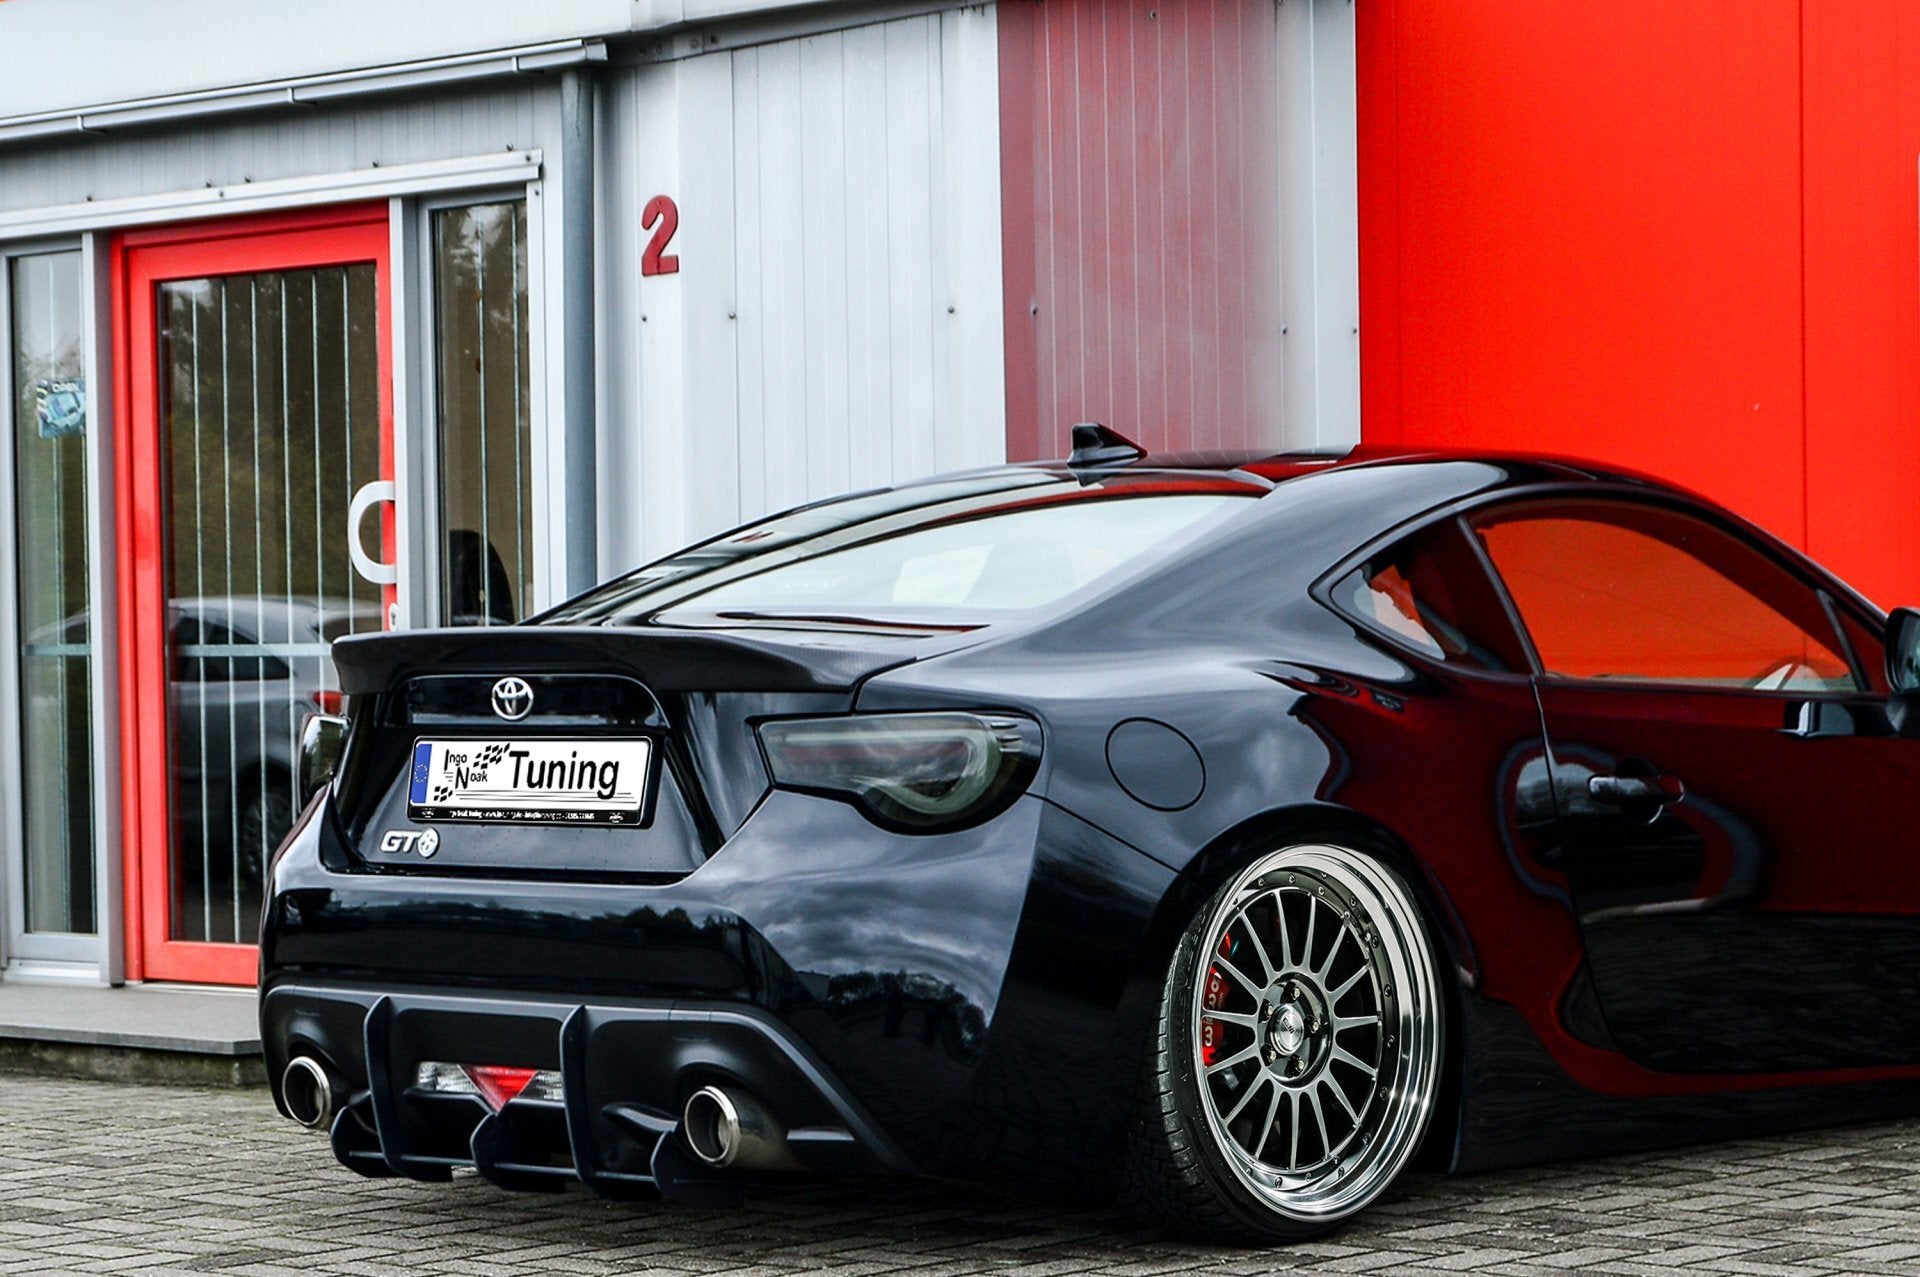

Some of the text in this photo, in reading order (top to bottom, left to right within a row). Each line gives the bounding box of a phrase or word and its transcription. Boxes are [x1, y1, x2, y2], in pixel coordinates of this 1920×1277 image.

[642, 195, 679, 276] 2
[444, 749, 467, 771] Ingo
[455, 766, 488, 789] Noak
[509, 750, 619, 799] Tuning
